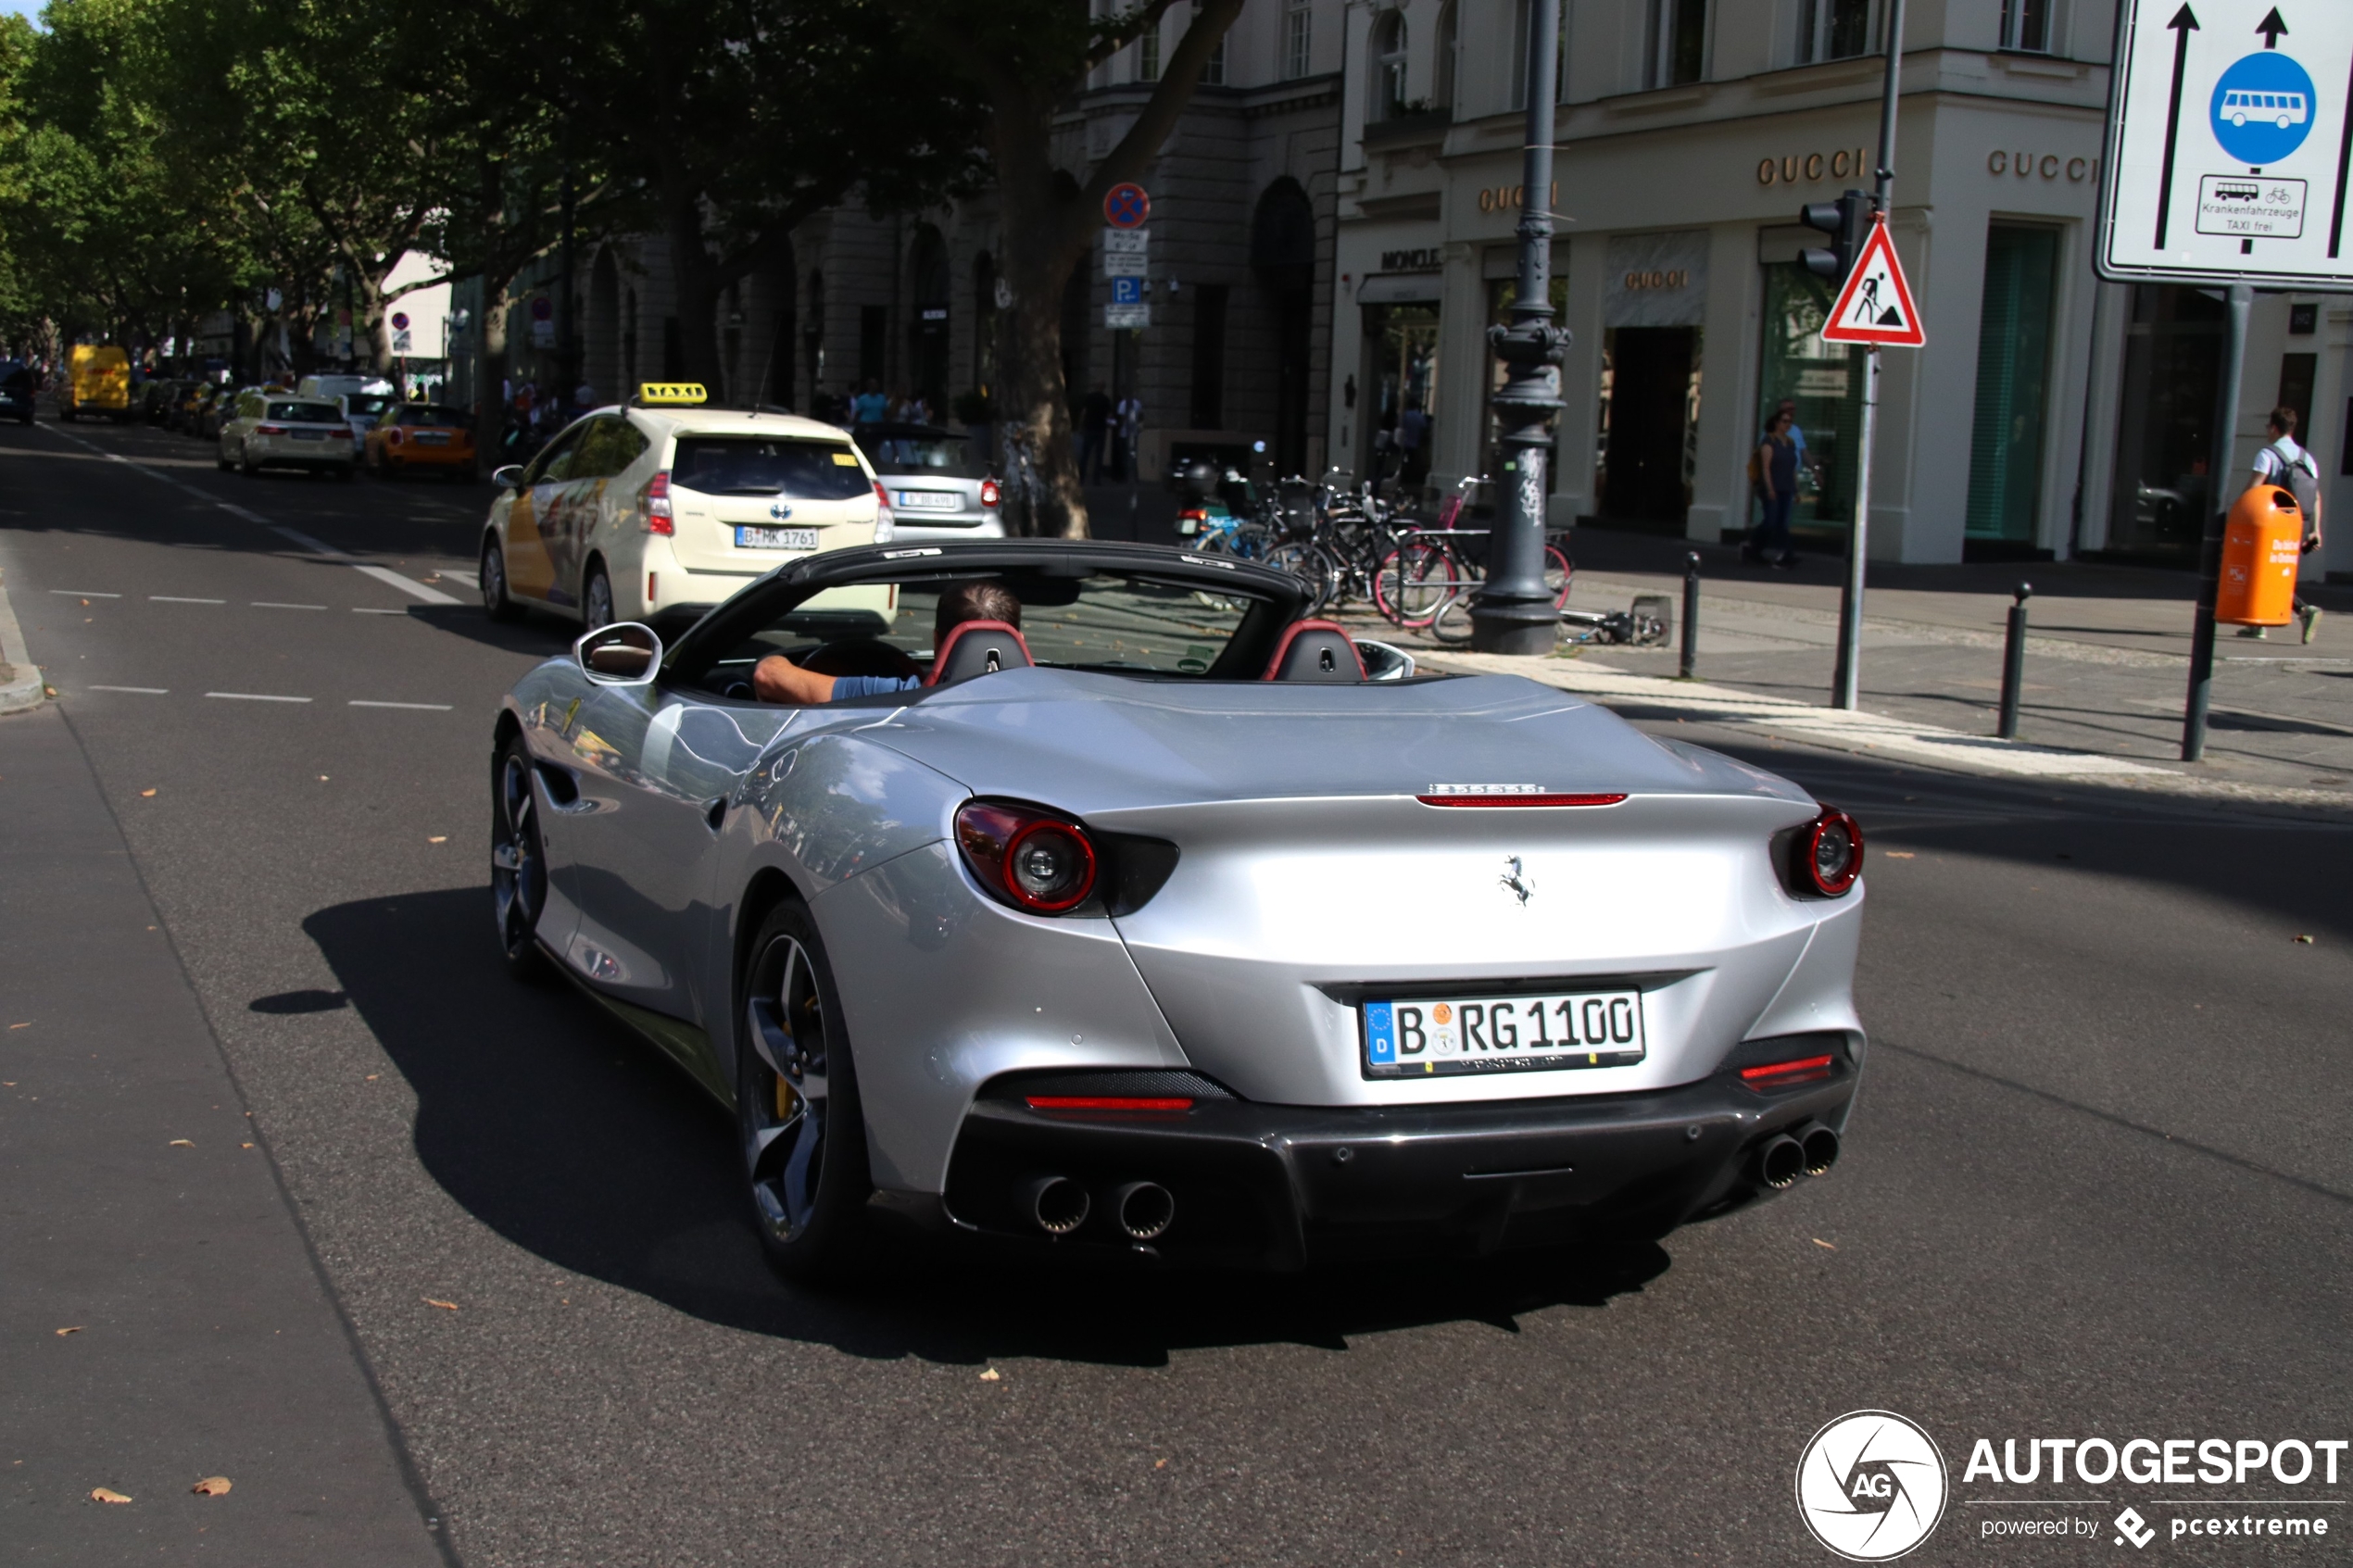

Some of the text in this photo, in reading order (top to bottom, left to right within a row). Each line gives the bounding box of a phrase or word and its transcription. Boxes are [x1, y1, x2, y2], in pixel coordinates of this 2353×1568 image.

[1757, 148, 1867, 185] GUCCI
[1987, 150, 2099, 184] GUCCI
[1478, 181, 1558, 212] GUCI
[2202, 204, 2299, 220] Krankenfahrzeuge
[2226, 220, 2273, 232] TAXI frei
[1626, 270, 1688, 290] GUCCI
[1117, 281, 1132, 301] P
[646, 386, 696, 397] TAXI
[745, 529, 817, 546] B MK 1761
[1376, 997, 1633, 1055] D B RG 1100
